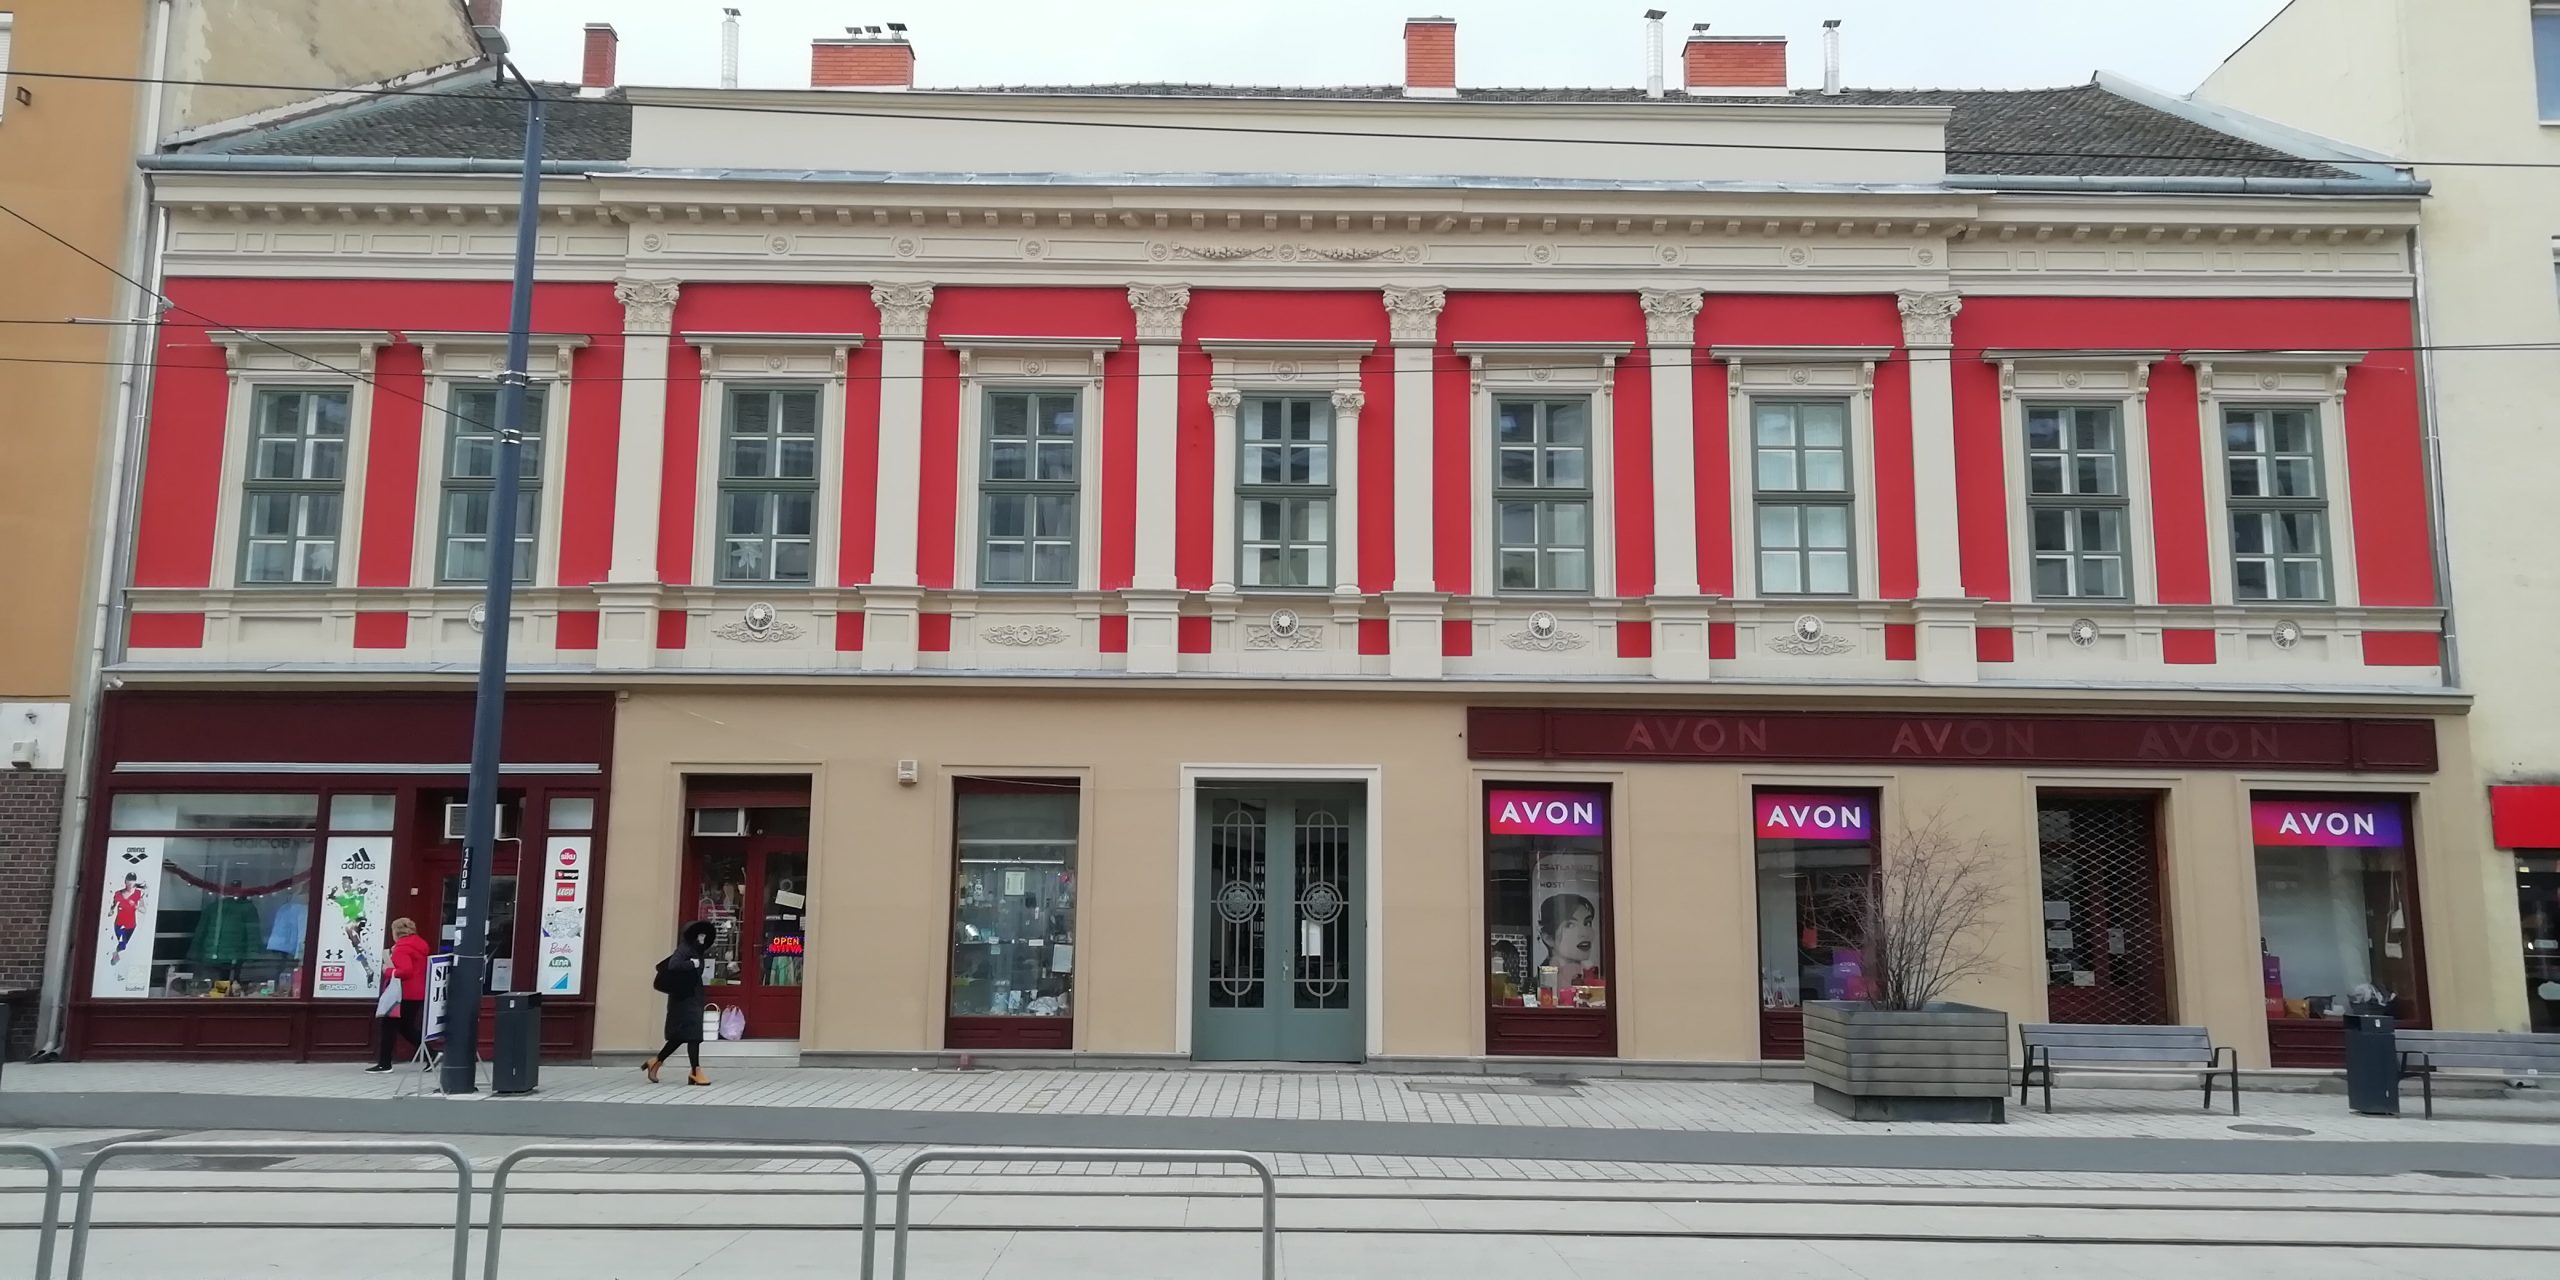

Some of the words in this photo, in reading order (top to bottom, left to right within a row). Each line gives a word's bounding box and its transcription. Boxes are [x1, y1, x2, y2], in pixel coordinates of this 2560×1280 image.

[1624, 718, 1767, 752] AVON
[1891, 721, 2034, 755] AVON
[2137, 724, 2279, 759] AVON
[1499, 801, 1593, 825] AVON
[1767, 805, 1861, 828] AVON
[2279, 812, 2375, 836] AVON
[341, 861, 376, 870] adidas
[557, 888, 574, 896] LEGO
[549, 942, 573, 954] Barbie
[773, 937, 800, 946] OPEN
